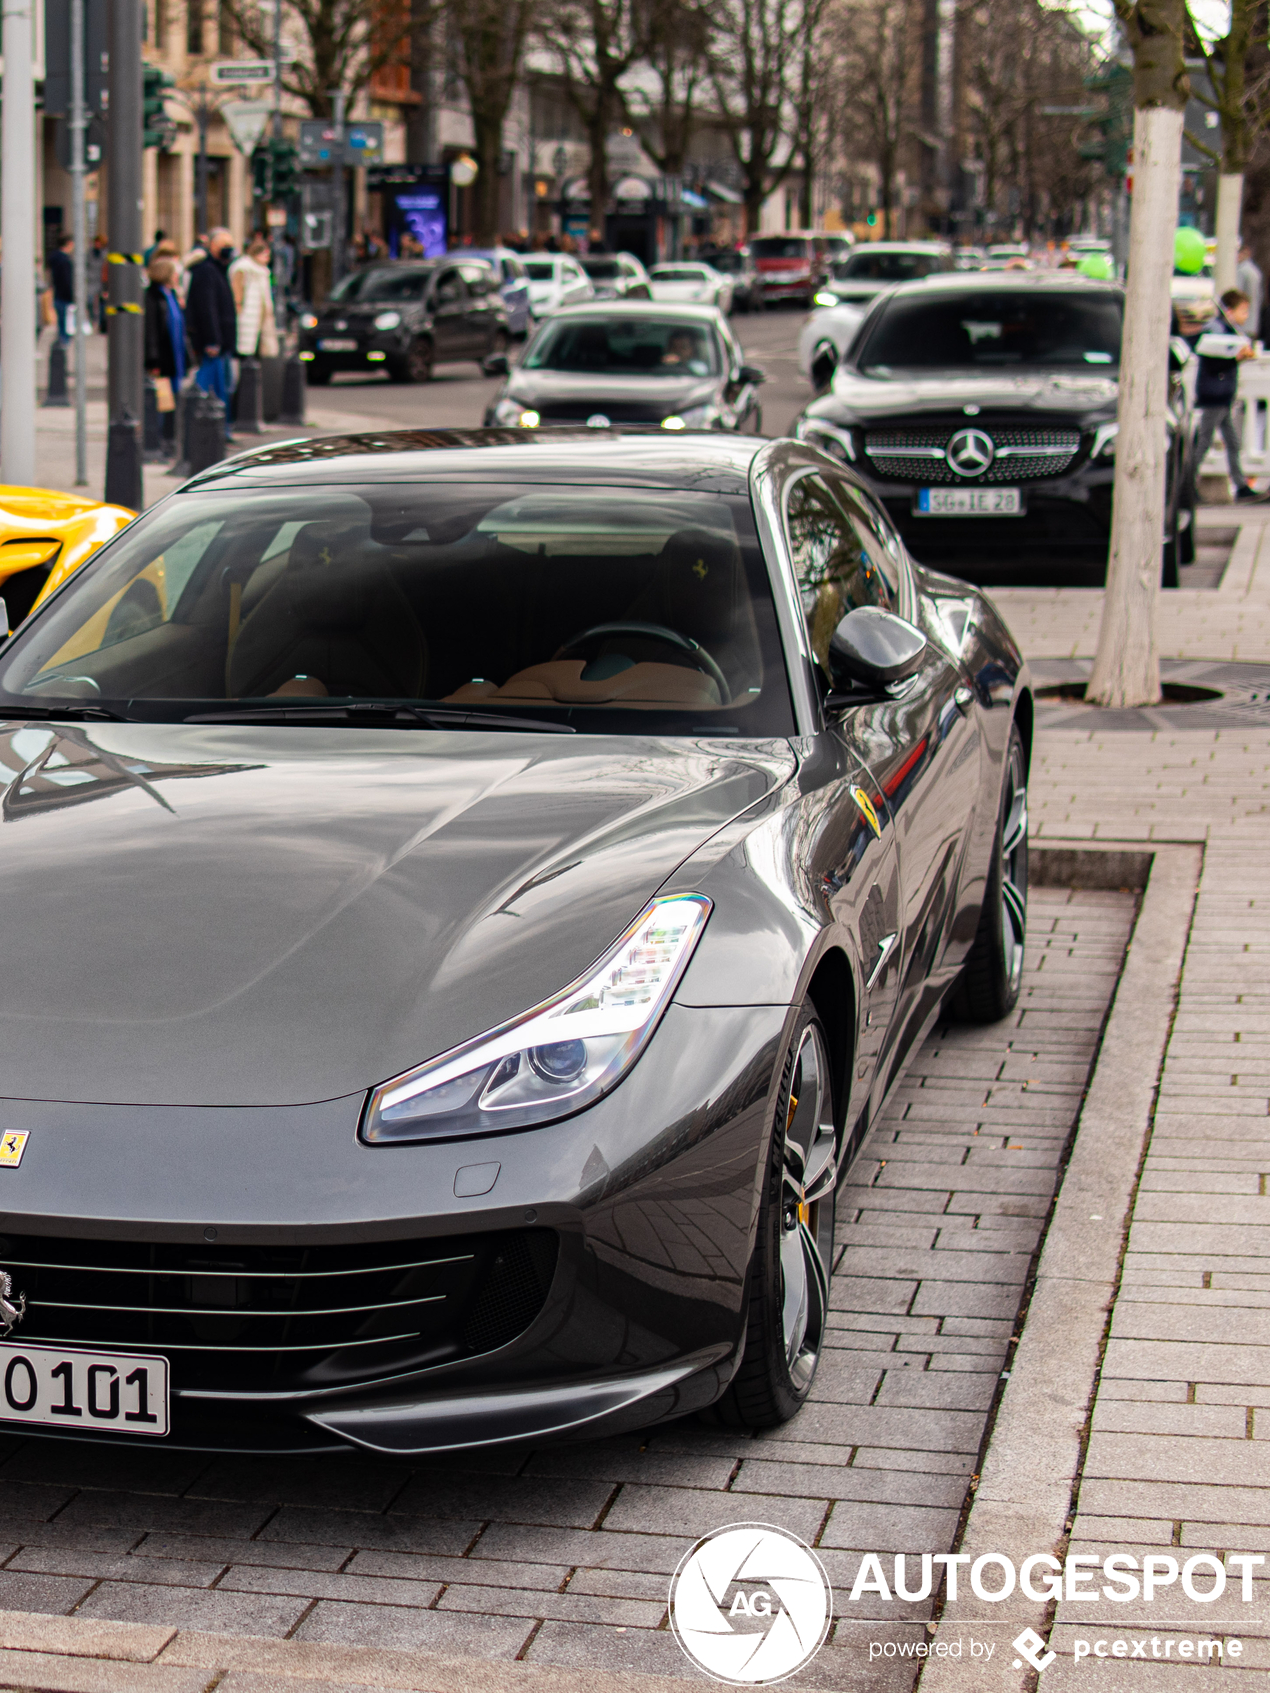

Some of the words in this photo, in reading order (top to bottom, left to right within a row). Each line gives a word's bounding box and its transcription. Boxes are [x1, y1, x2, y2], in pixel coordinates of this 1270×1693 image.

[933, 493, 955, 512] SG
[994, 493, 1016, 512] 28
[50, 1360, 158, 1424] 101
